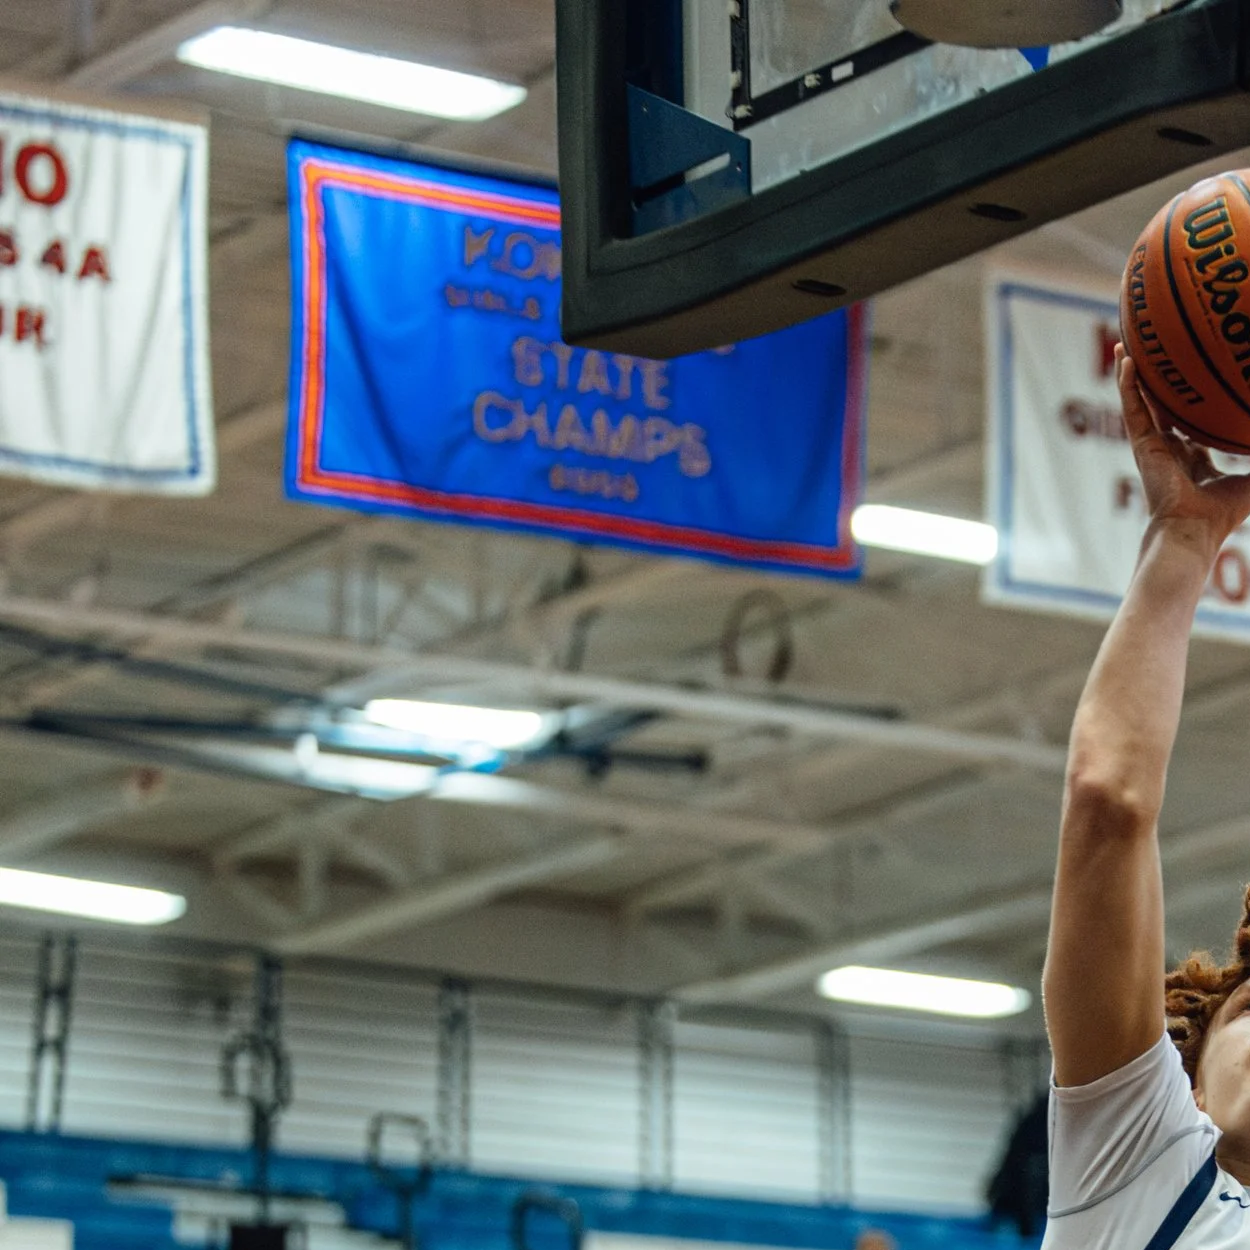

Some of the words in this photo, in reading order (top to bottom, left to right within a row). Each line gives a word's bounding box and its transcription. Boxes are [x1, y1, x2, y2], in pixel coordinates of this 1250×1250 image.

[0, 140, 68, 207] O
[41, 240, 112, 284] 4A
[512, 337, 671, 410] STATE
[473, 391, 711, 478] CHAMPS
